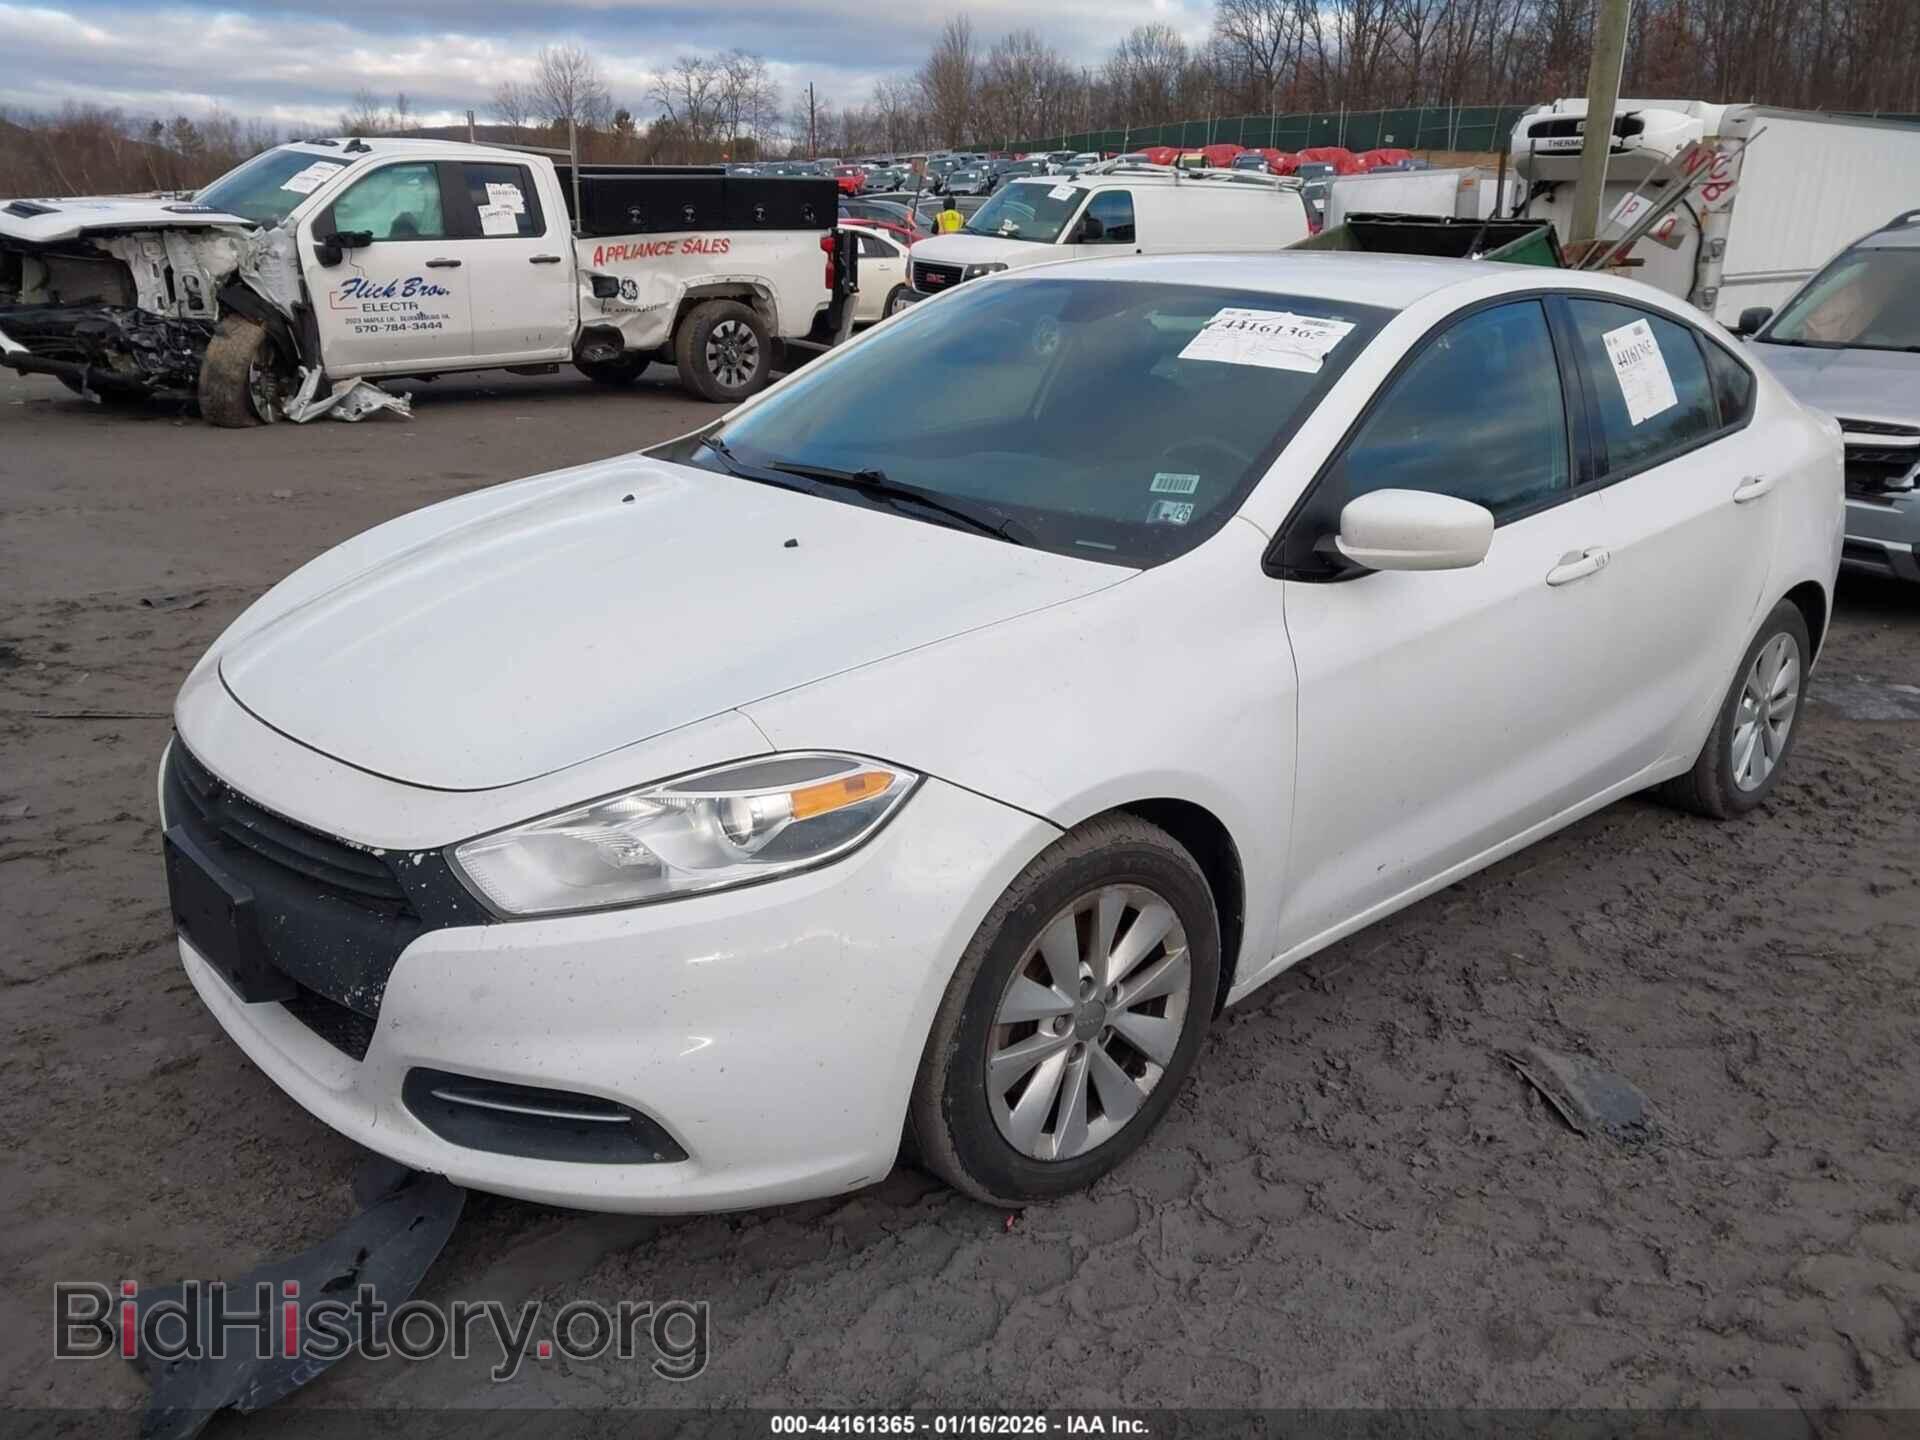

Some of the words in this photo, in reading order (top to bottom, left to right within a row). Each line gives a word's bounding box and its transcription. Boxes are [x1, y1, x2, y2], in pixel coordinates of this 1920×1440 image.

[593, 241, 676, 266] APPLIANCE
[681, 238, 731, 254] SALES
[354, 321, 443, 334] 570-784-3444
